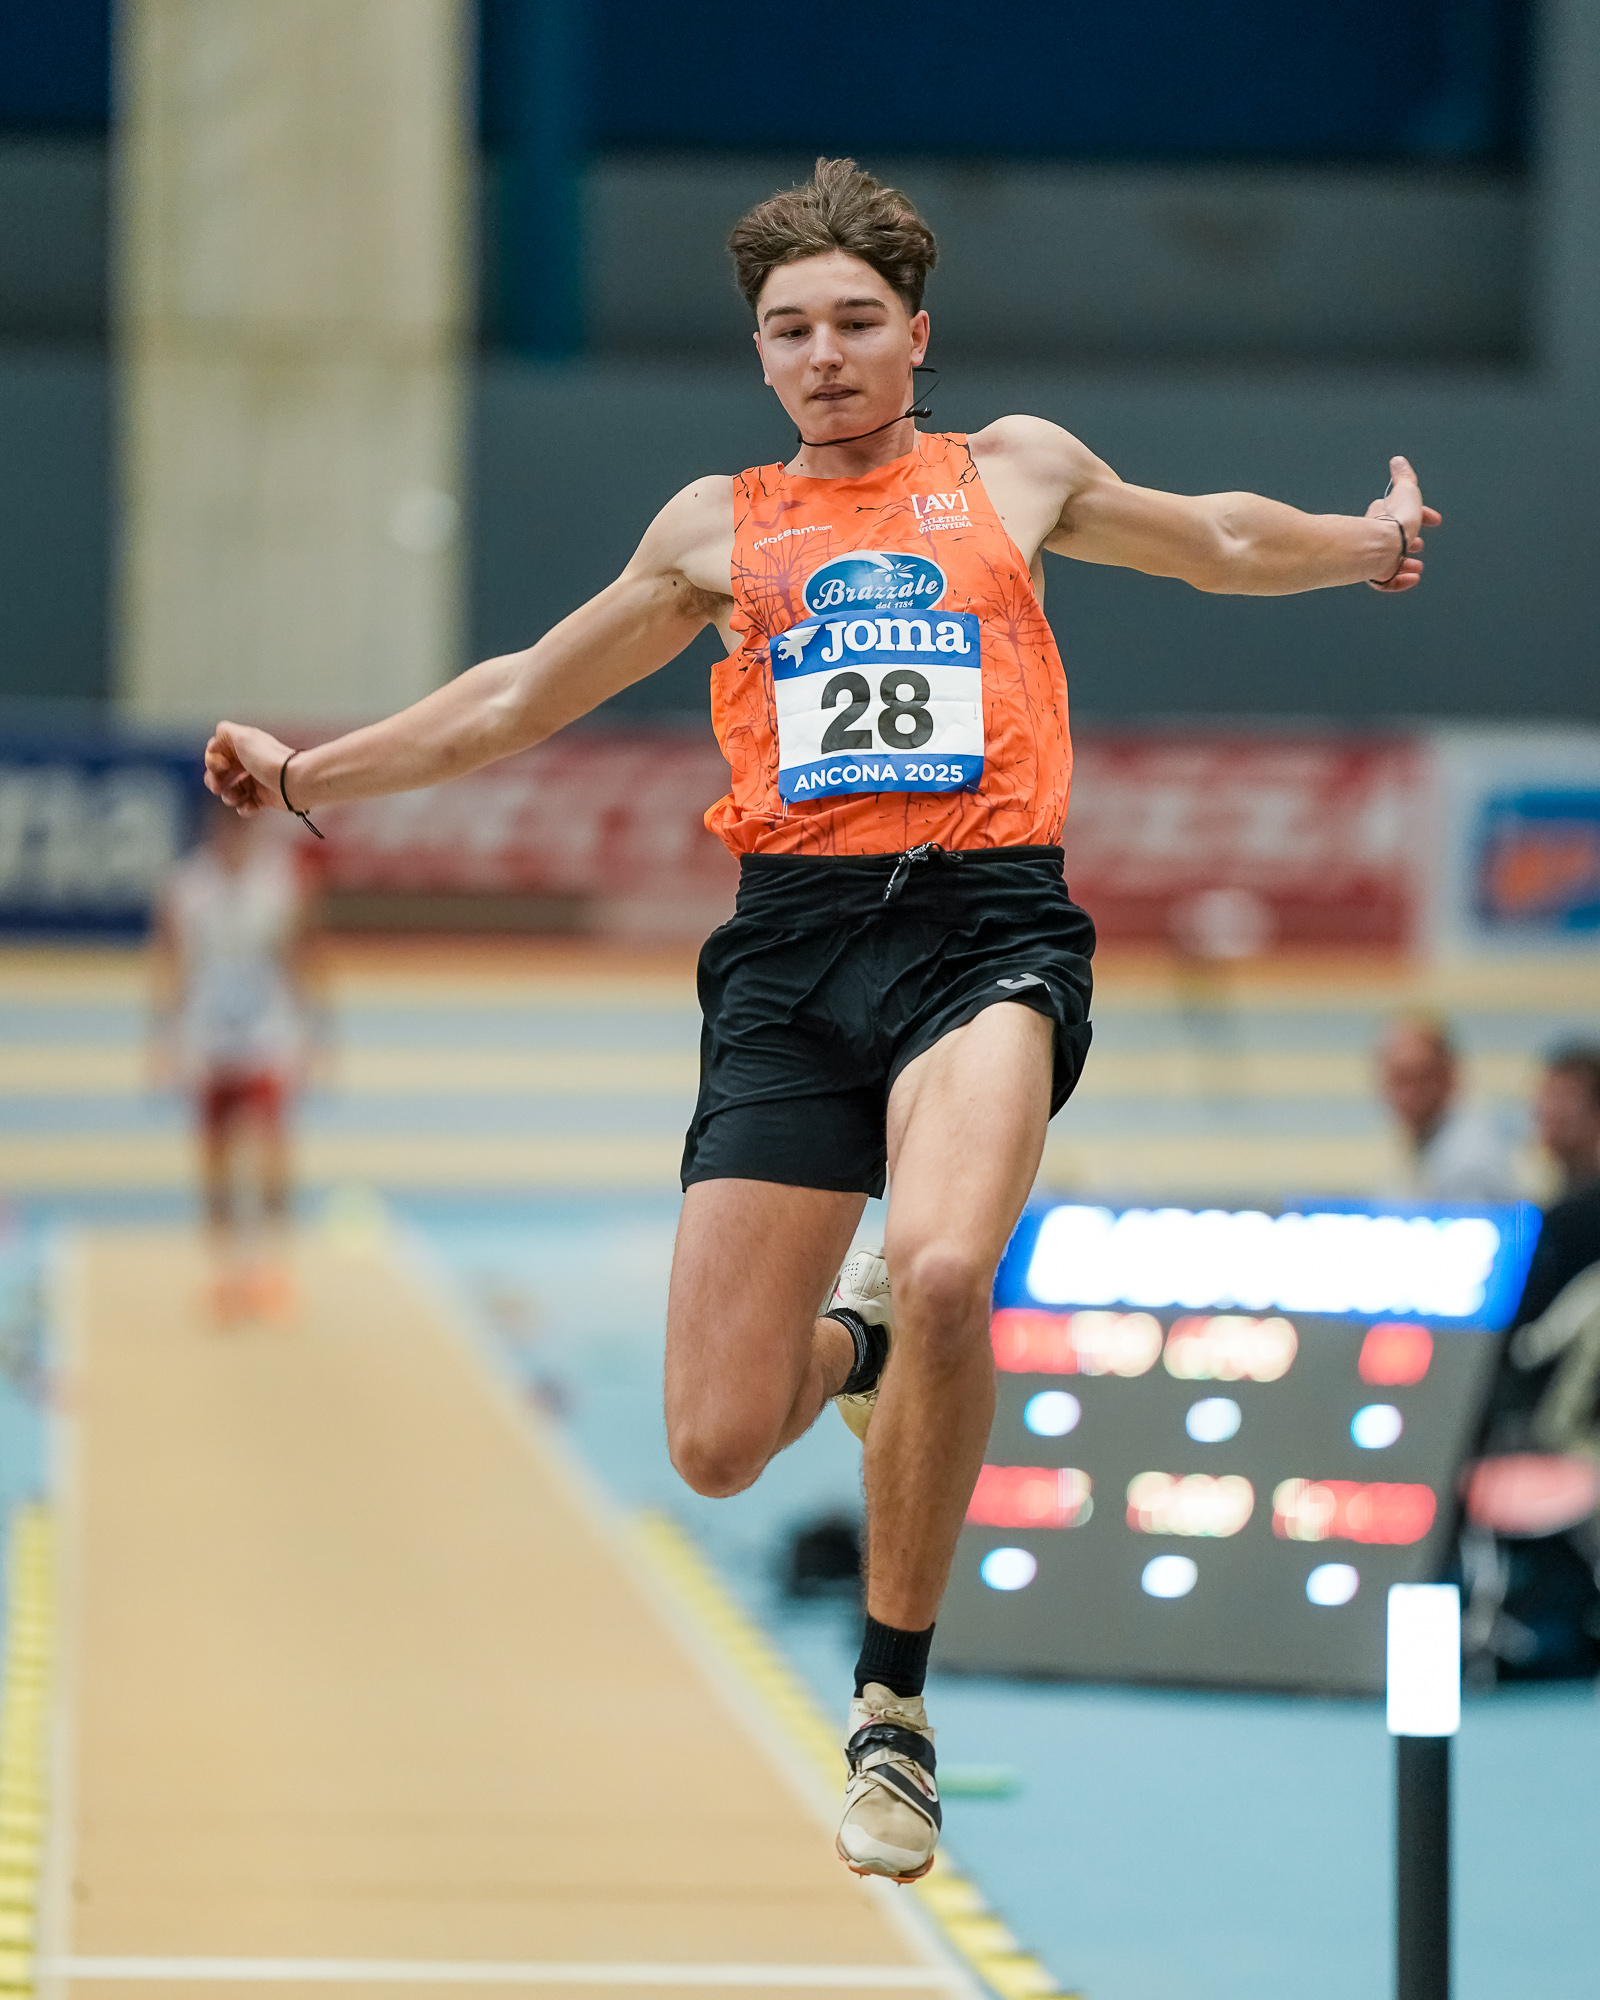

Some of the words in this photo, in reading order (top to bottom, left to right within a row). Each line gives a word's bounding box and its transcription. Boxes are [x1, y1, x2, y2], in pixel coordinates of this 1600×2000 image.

[918, 521, 973, 534] VICENTINA
[920, 515, 969, 527] ATLETICA
[754, 525, 832, 551] tuoteam.com
[812, 573, 939, 610] Brazzale
[875, 601, 891, 610] dal
[894, 600, 914, 609] 1784
[820, 670, 934, 755] 28
[793, 764, 899, 793] ANCONA
[904, 763, 964, 783] 2025
